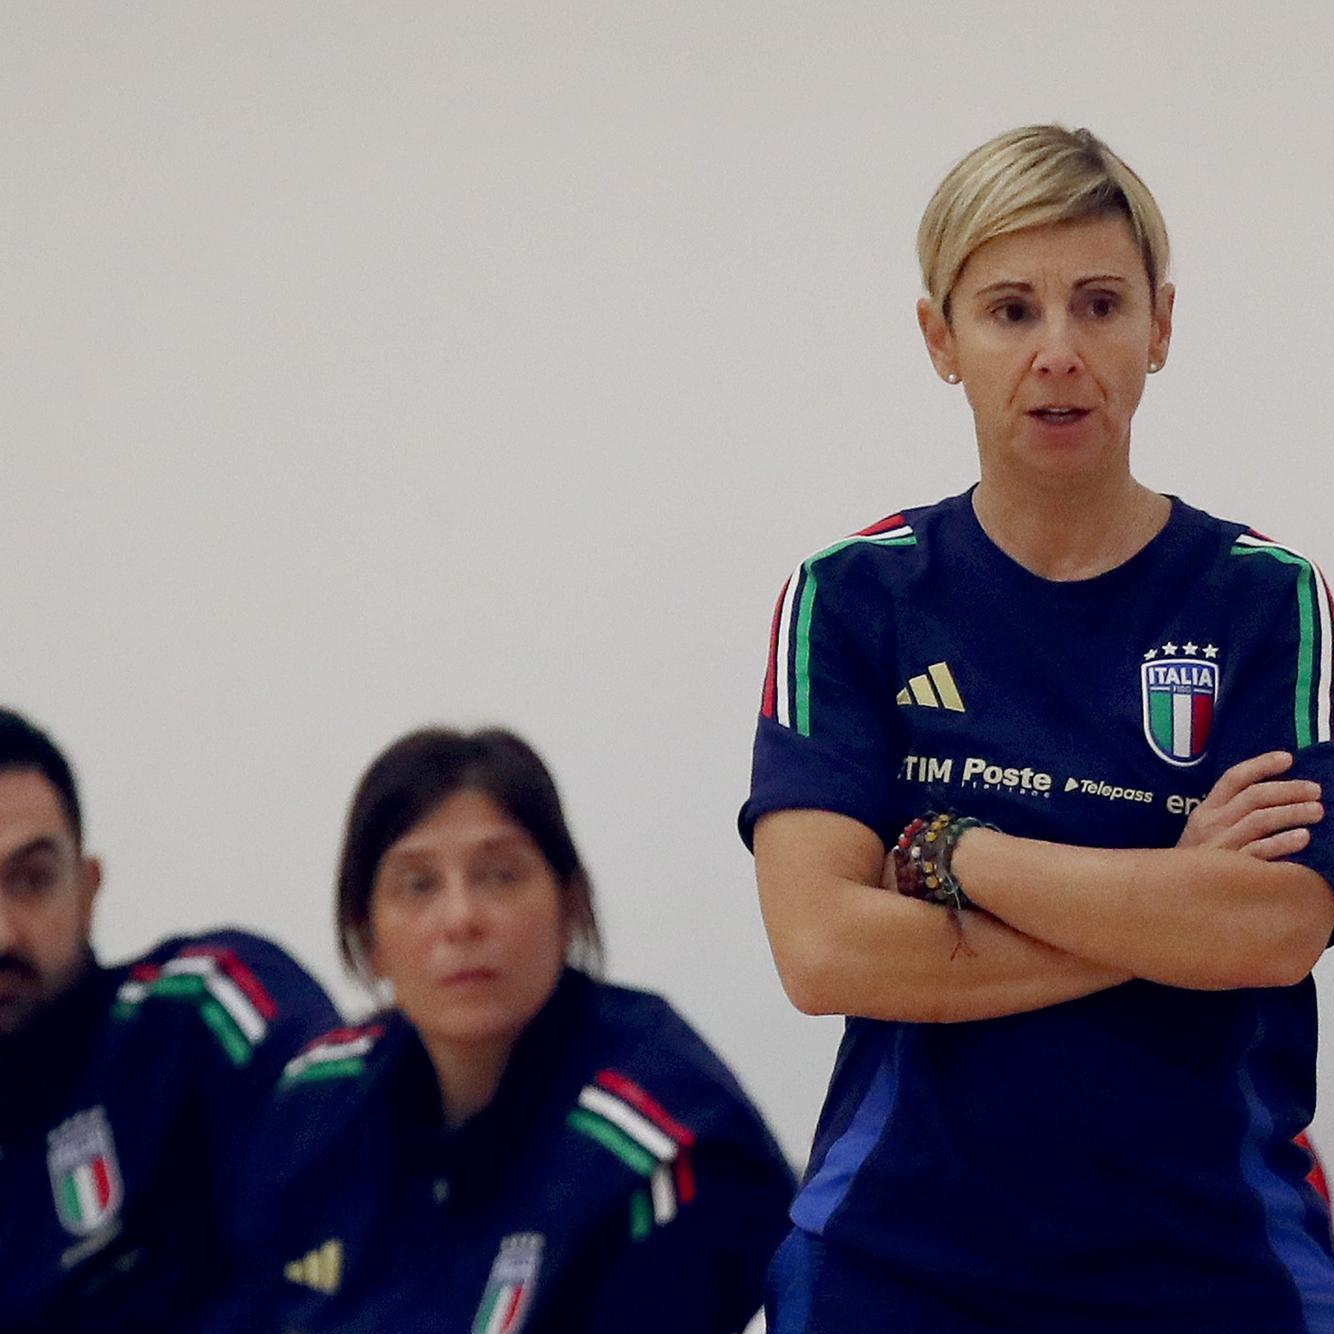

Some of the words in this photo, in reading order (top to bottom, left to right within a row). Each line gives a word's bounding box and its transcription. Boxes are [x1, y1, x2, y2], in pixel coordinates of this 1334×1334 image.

[1148, 667, 1214, 688] ITALIA
[905, 755, 953, 783] TIM
[962, 757, 1052, 791] Poste
[1080, 779, 1154, 803] Telepass
